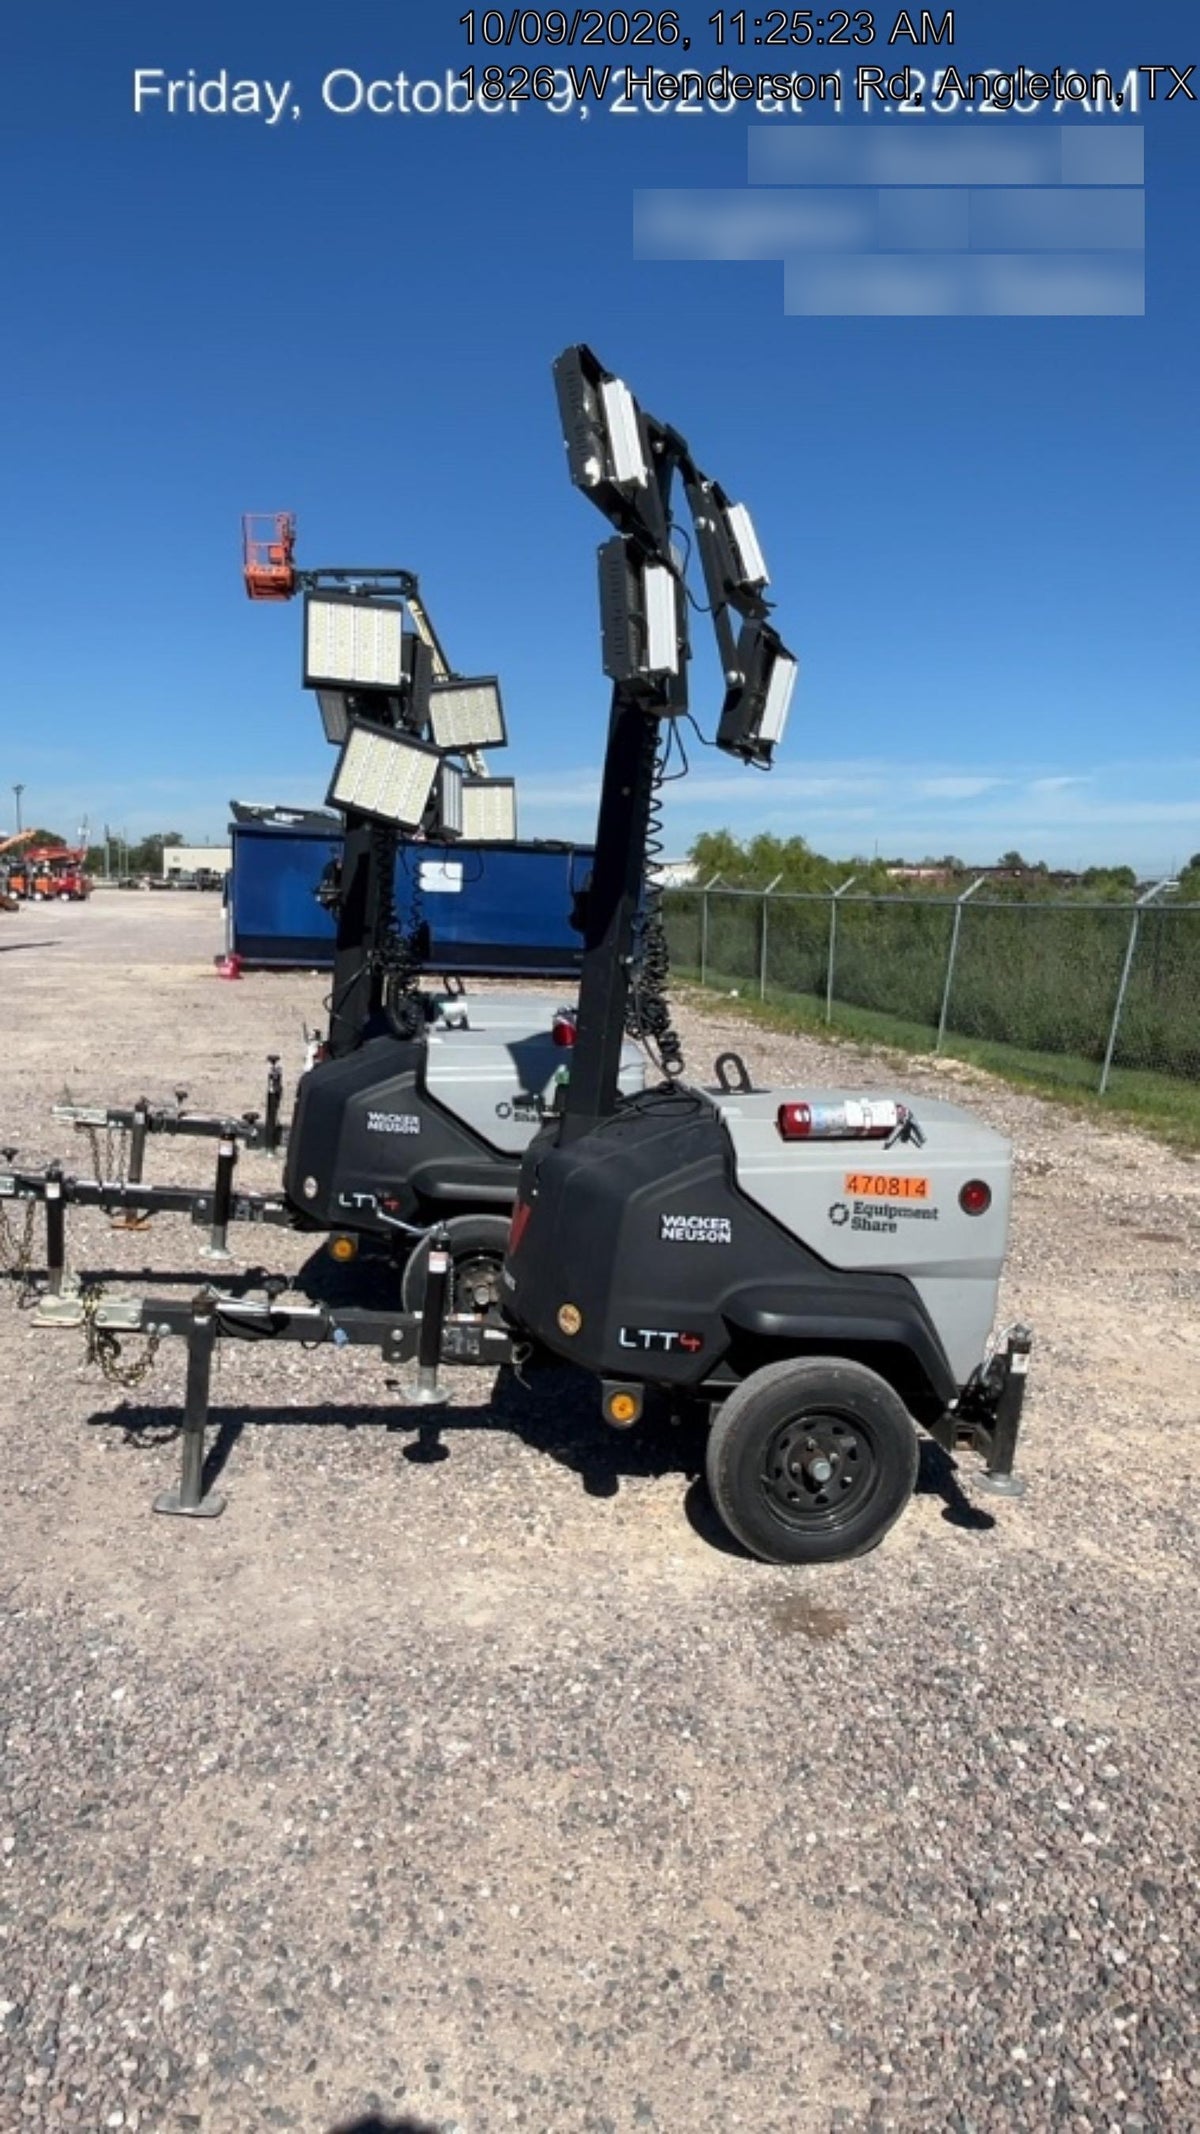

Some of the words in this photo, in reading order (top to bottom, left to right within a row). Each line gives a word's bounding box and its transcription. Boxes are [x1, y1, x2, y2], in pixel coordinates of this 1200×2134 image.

[846, 1175, 927, 1198] 470814
[852, 1200, 939, 1220] Equipment
[661, 1213, 731, 1229] WACKER
[850, 1216, 898, 1234] Share
[660, 1227, 732, 1244] NEUSON
[618, 1326, 701, 1352] LTT4
